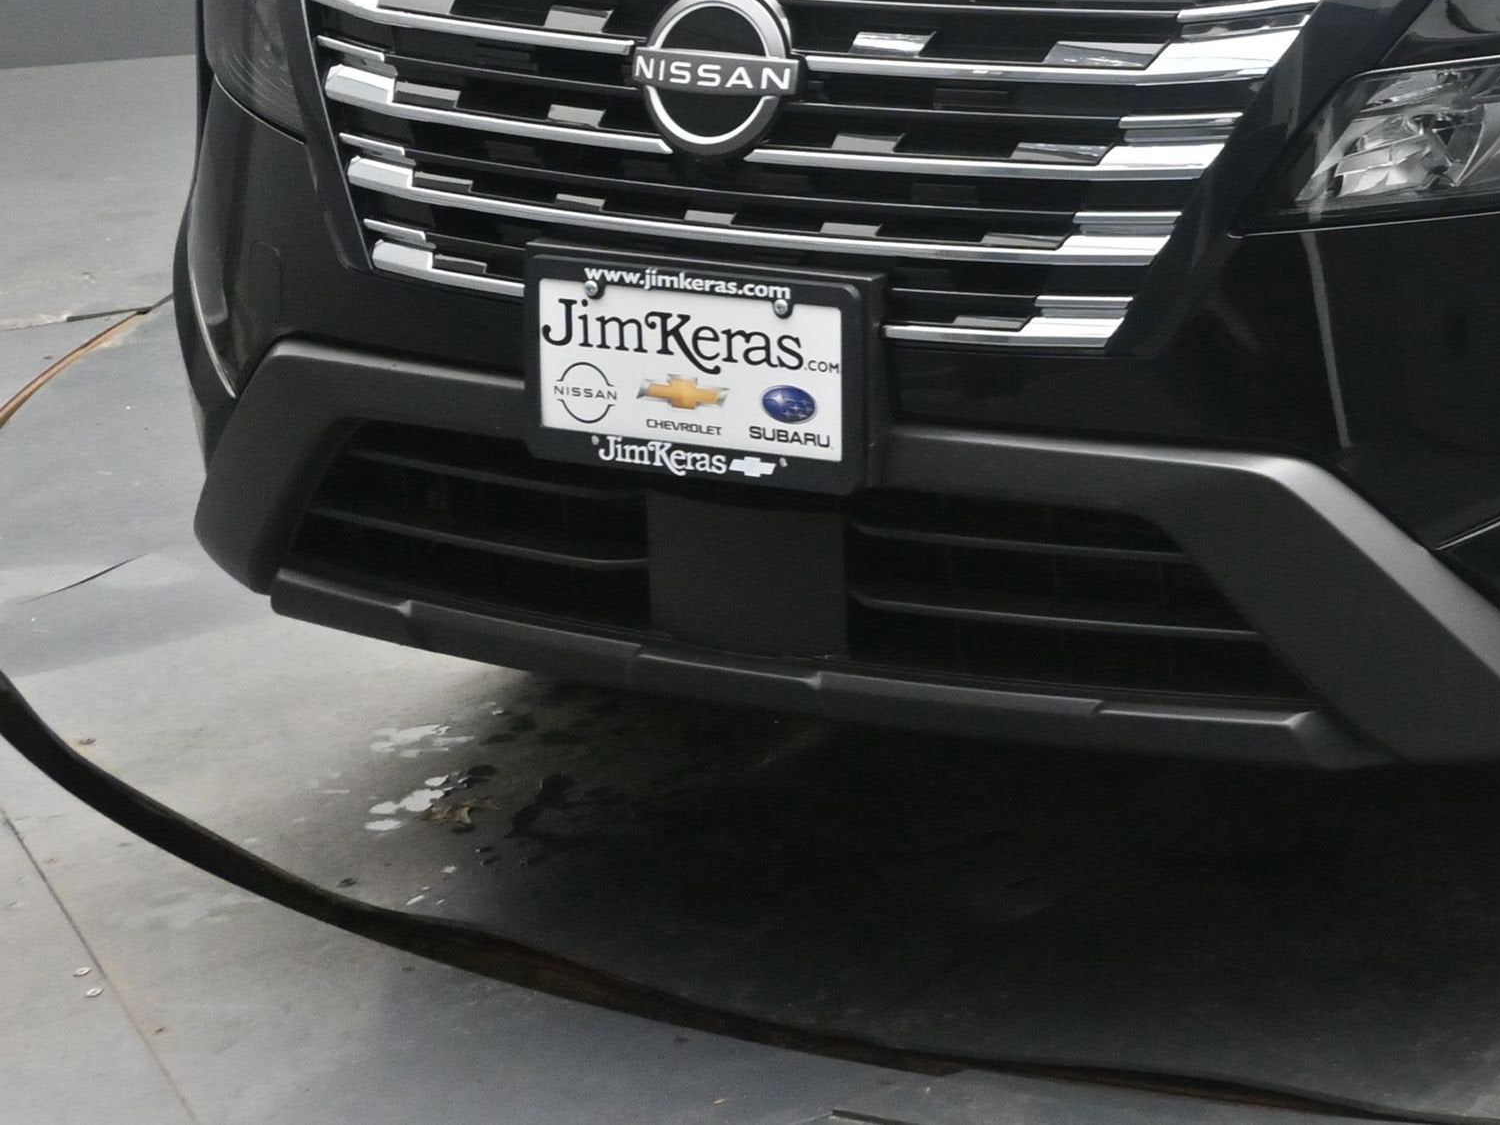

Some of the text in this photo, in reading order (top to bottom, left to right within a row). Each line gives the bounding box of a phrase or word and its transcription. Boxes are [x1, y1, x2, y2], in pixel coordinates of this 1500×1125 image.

[634, 55, 791, 90] NISSAN
[584, 267, 791, 300] www.jimkeras.com
[553, 384, 618, 402] NISSAN
[646, 418, 722, 436] CHEVROLET
[749, 425, 831, 448] SUBARU
